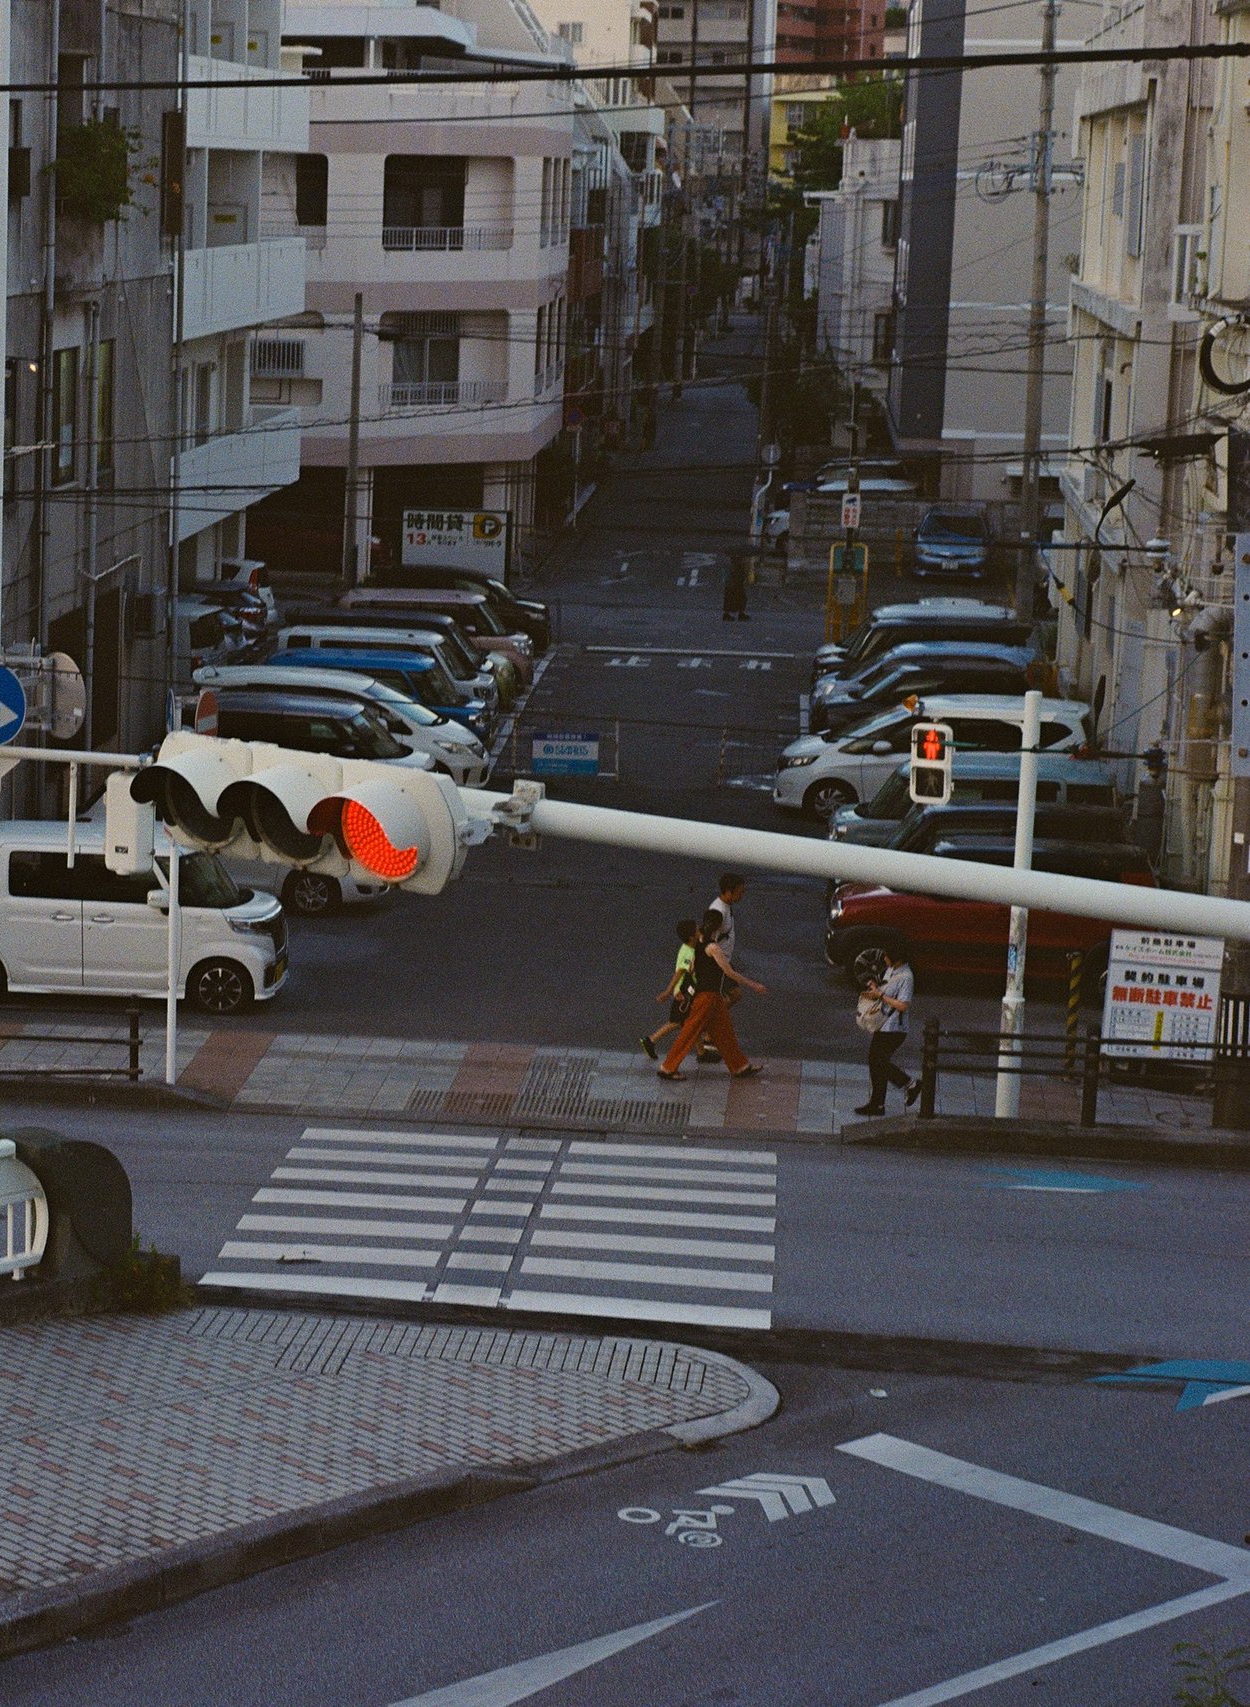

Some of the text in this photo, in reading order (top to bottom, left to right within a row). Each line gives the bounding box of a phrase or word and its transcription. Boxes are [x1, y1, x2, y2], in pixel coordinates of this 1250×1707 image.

[1124, 970, 1204, 989] 契約駐車場
[1112, 985, 1213, 1010] 無断駐車禁止
